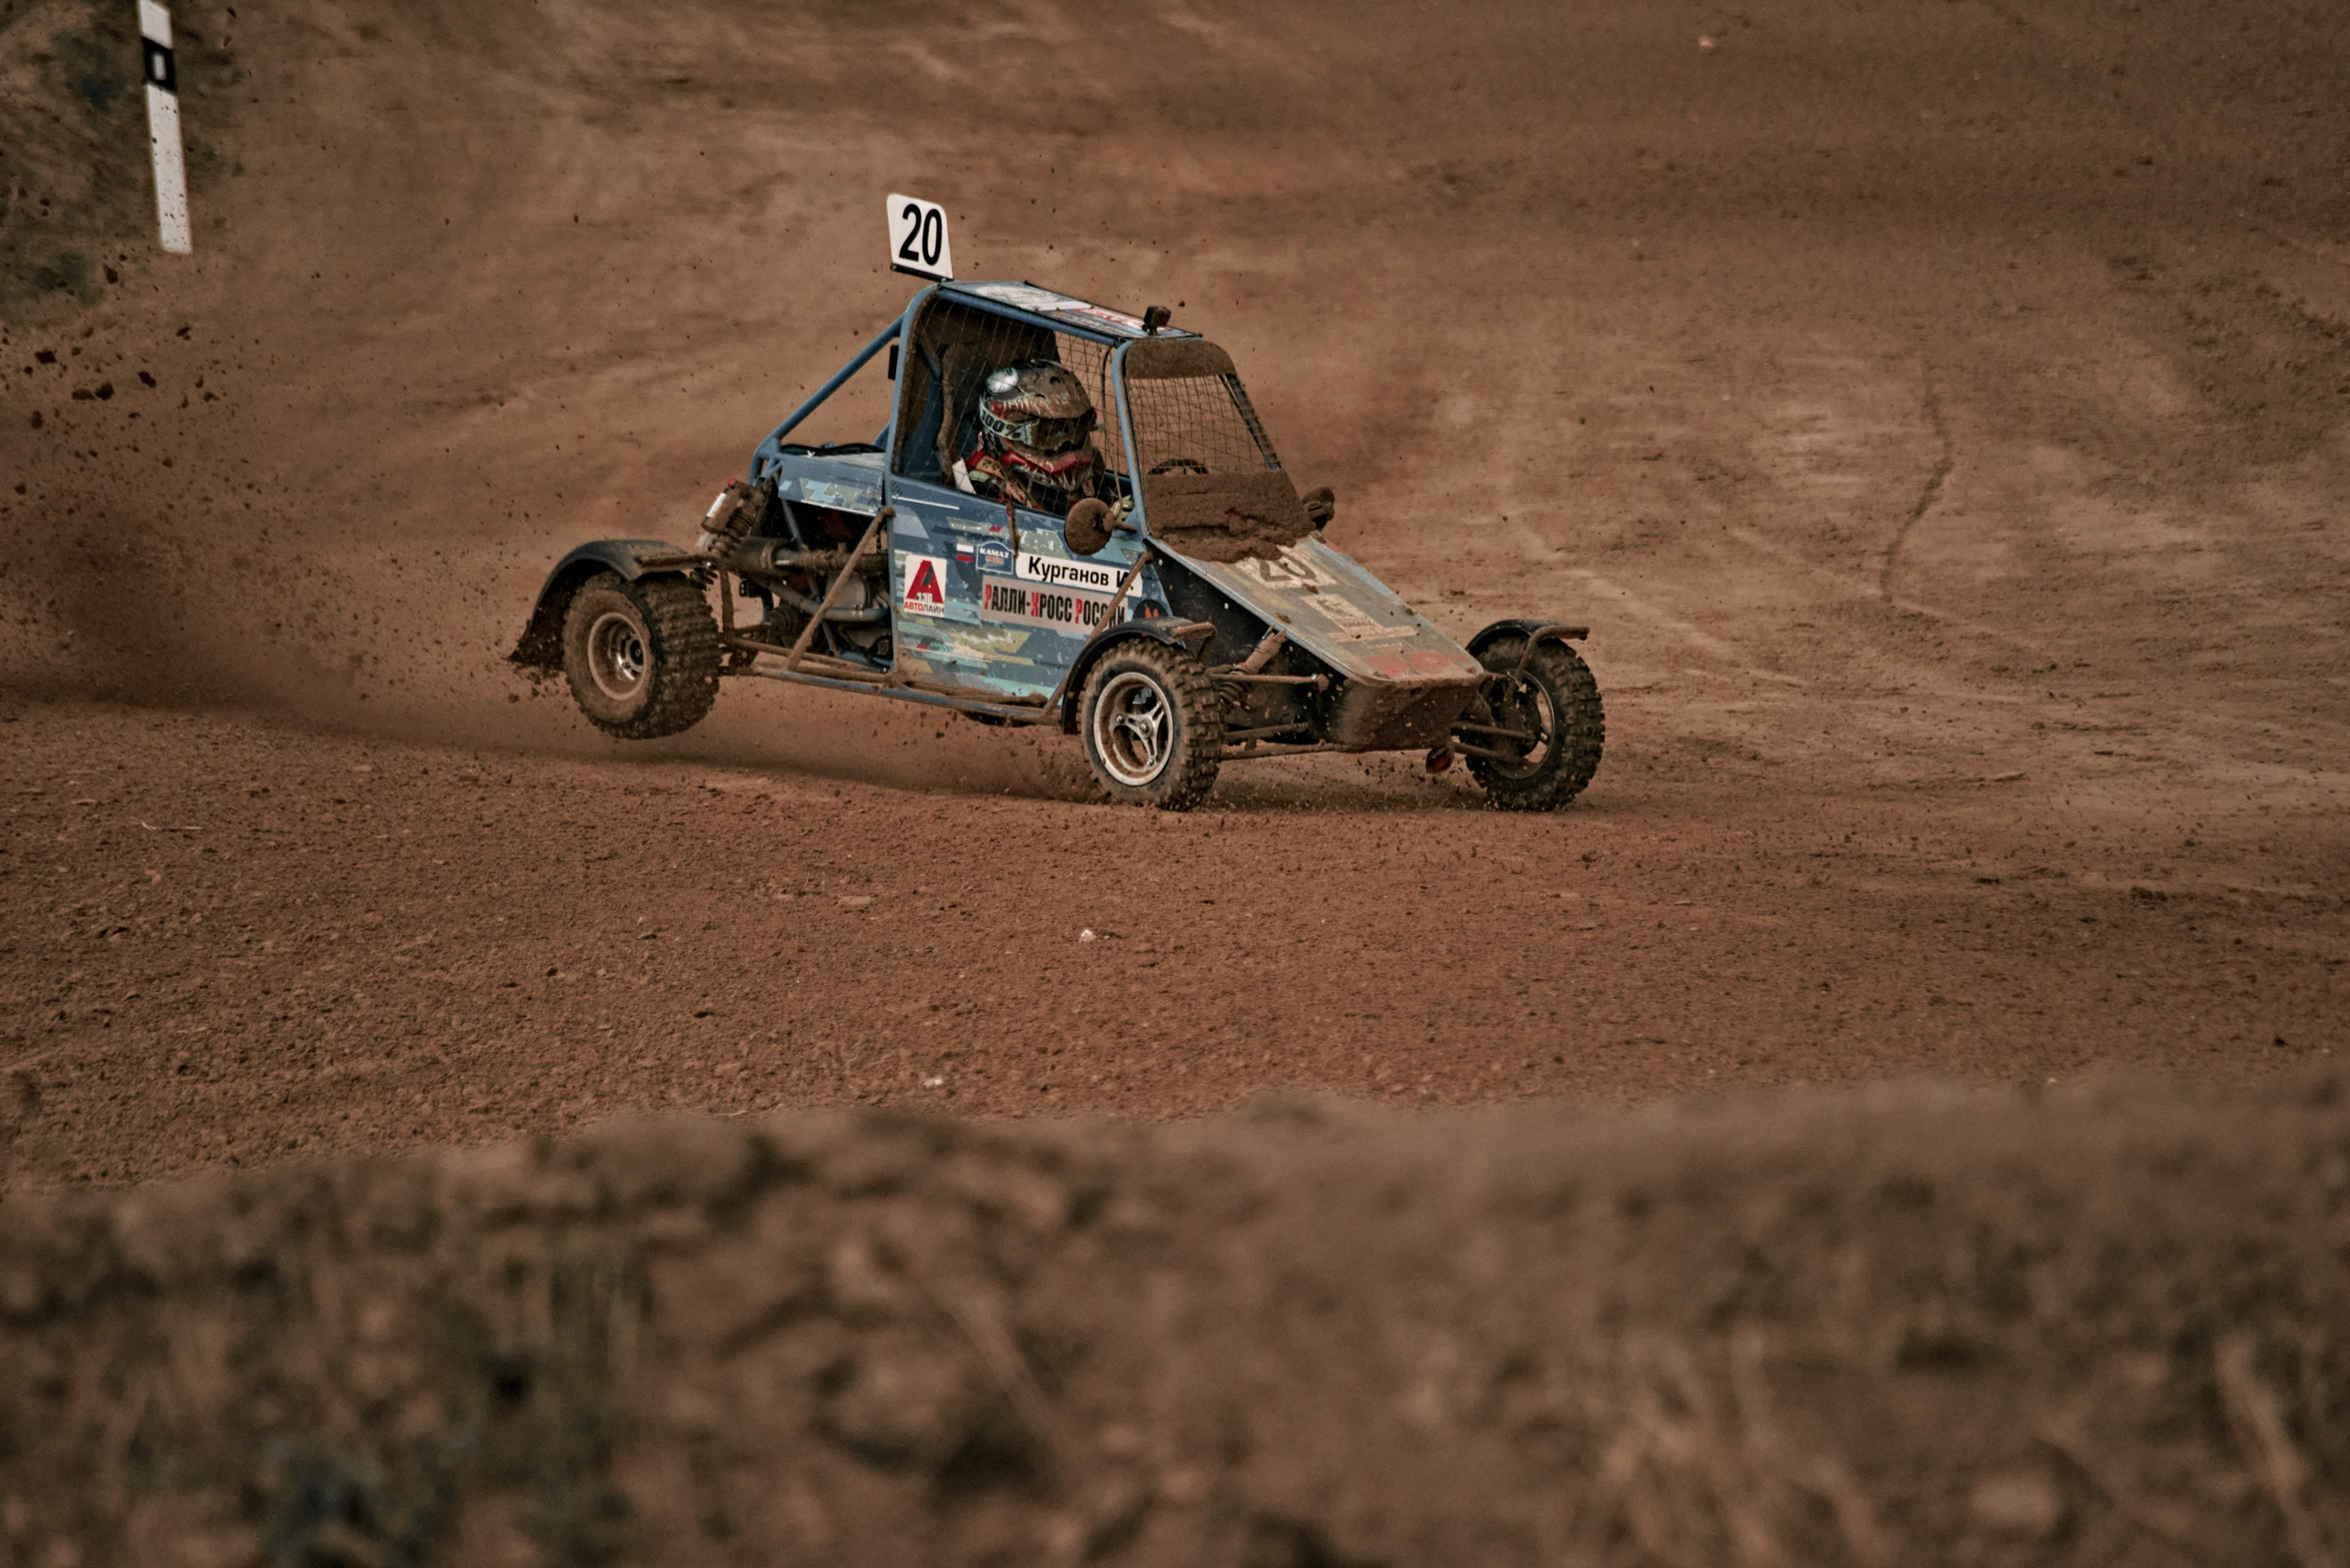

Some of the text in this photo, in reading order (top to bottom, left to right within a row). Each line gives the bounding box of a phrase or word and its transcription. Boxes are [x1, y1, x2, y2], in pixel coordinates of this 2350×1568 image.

[899, 203, 943, 266] 20
[981, 409, 1022, 439] 100%
[979, 547, 1010, 559] KAMAZ
[1028, 556, 1109, 586] Курганов
[903, 601, 945, 614] АВТОЛАЙН
[984, 584, 1072, 622] РАЛЛИ-КРОСС
